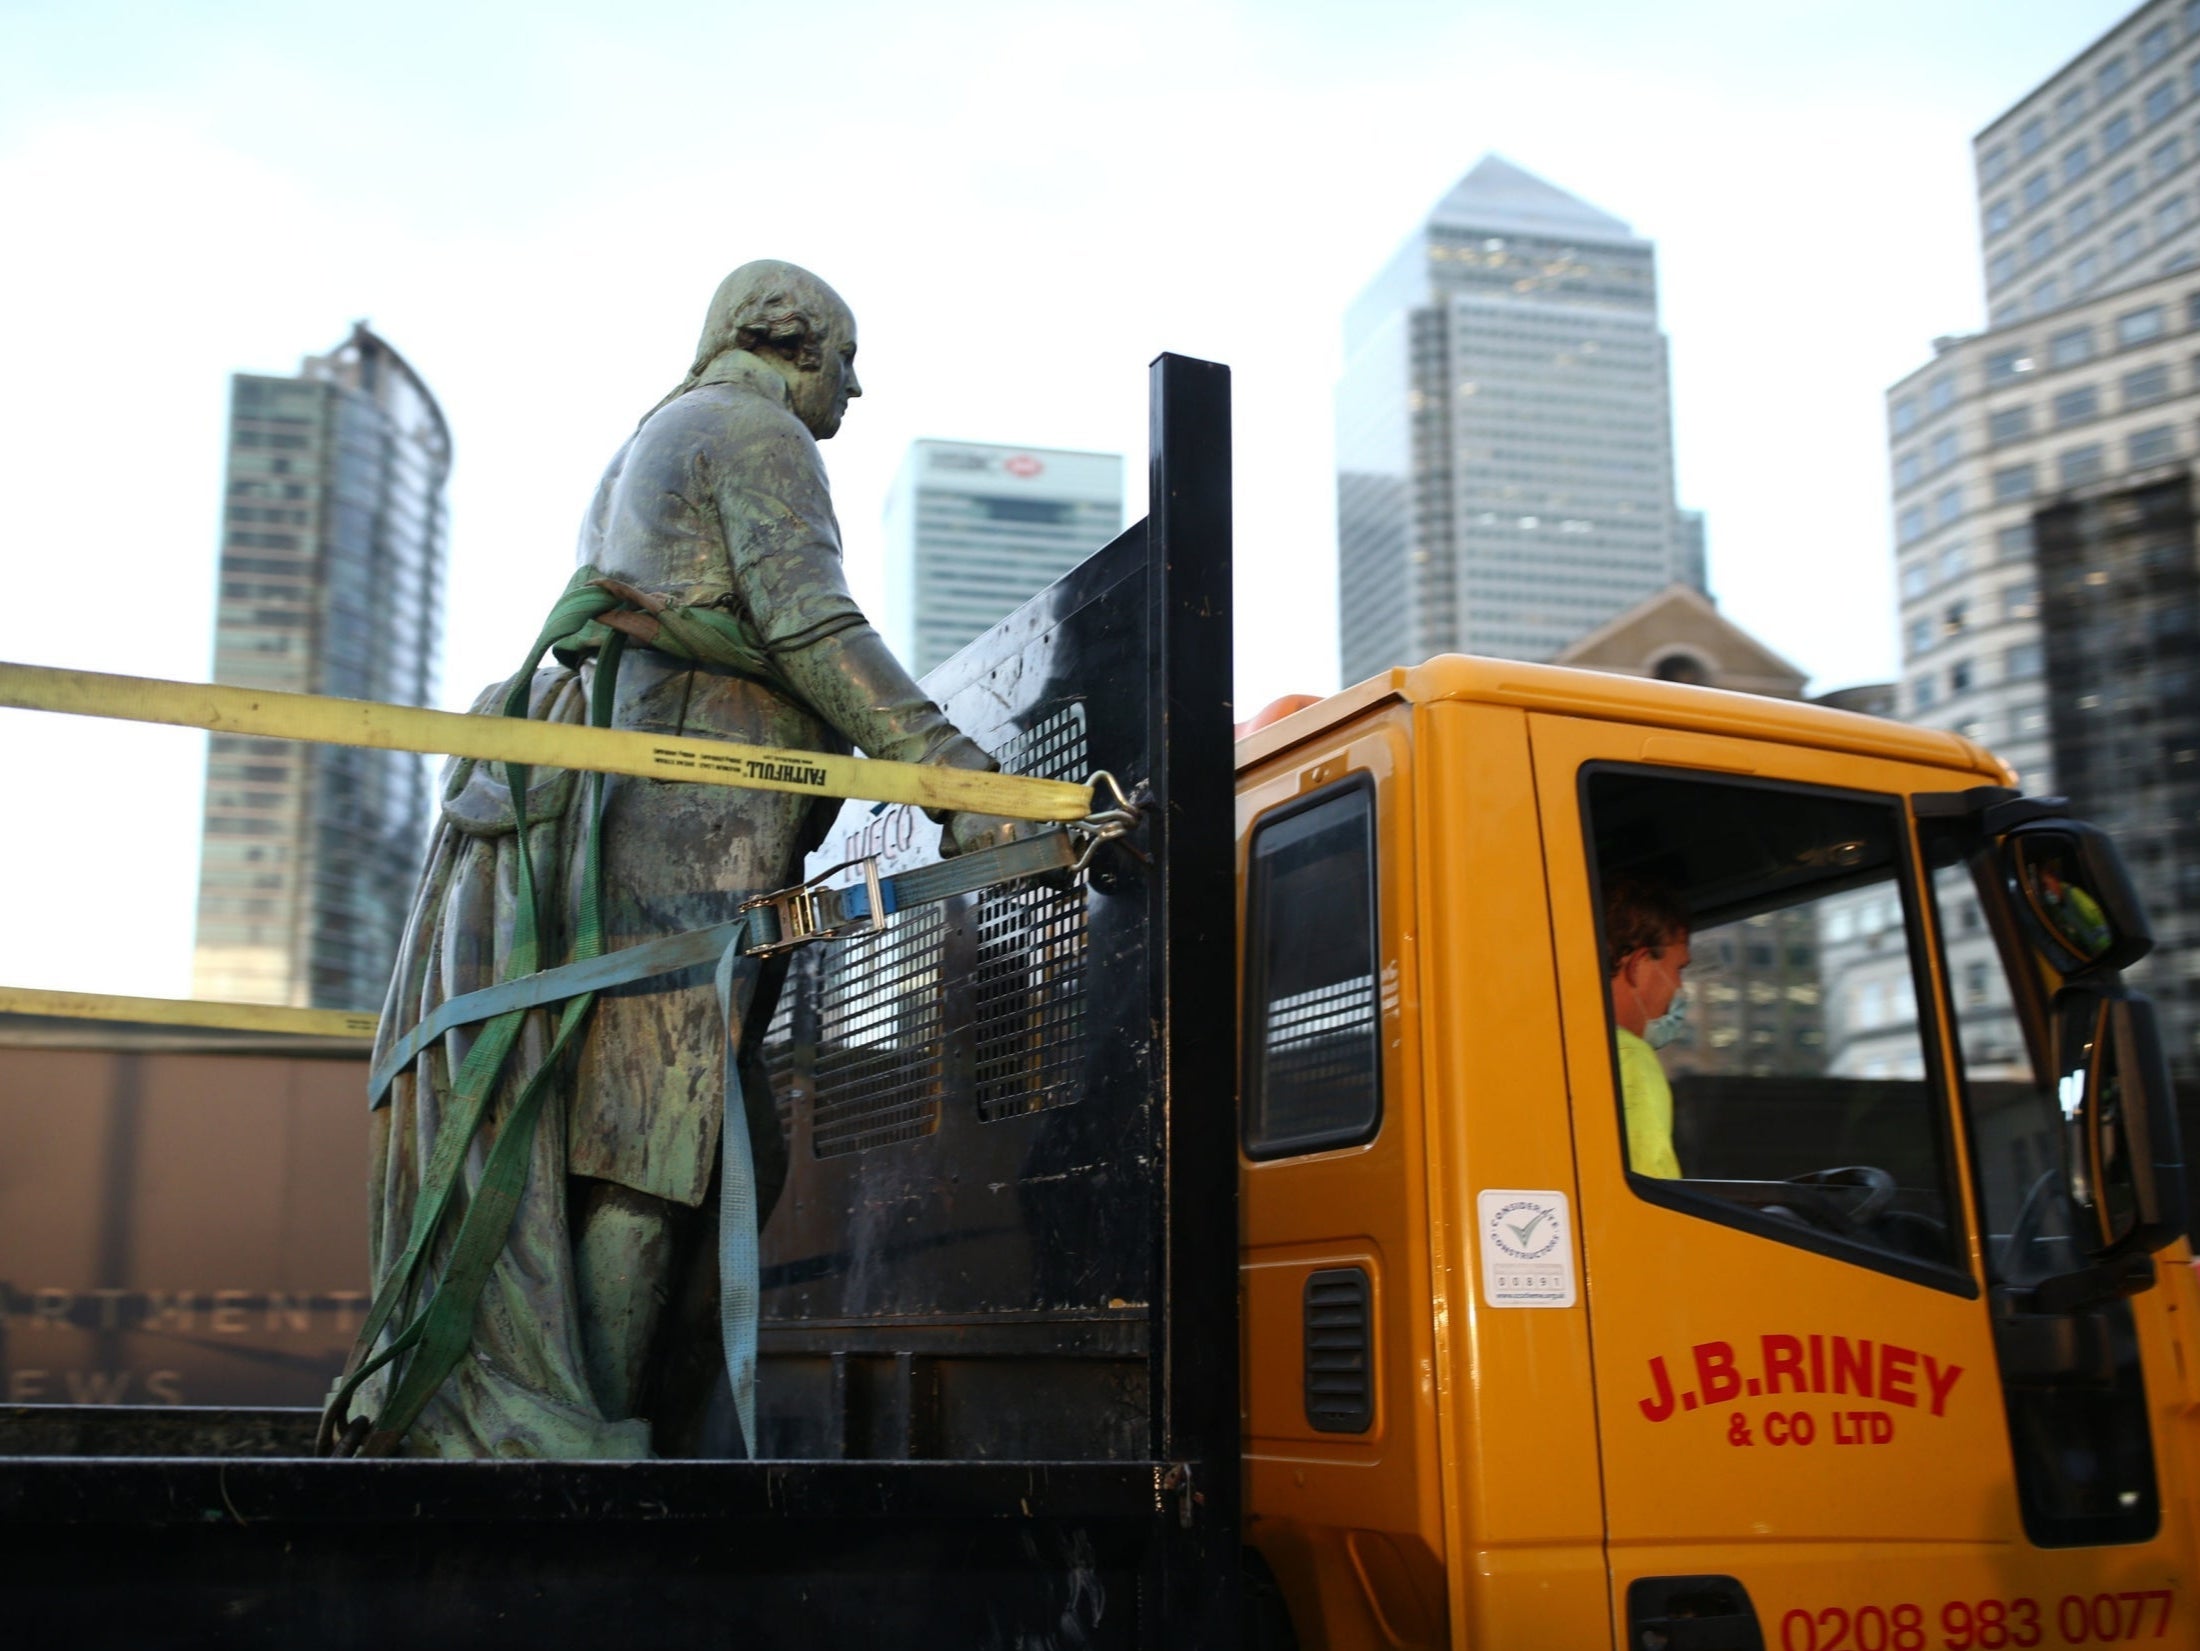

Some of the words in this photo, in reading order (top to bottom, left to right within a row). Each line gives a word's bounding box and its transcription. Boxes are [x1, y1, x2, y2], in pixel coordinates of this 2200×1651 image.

[746, 761, 827, 786] FAITHFULL
[0, 1287, 364, 1334] RTMENT
[1727, 1412, 1754, 1447] &
[1763, 1411, 1815, 1446] CO
[1832, 1411, 1894, 1445] LTD
[1780, 1603, 1927, 1651] 0208
[1938, 1598, 2042, 1651] 983
[2058, 1589, 2174, 1645] 0077
